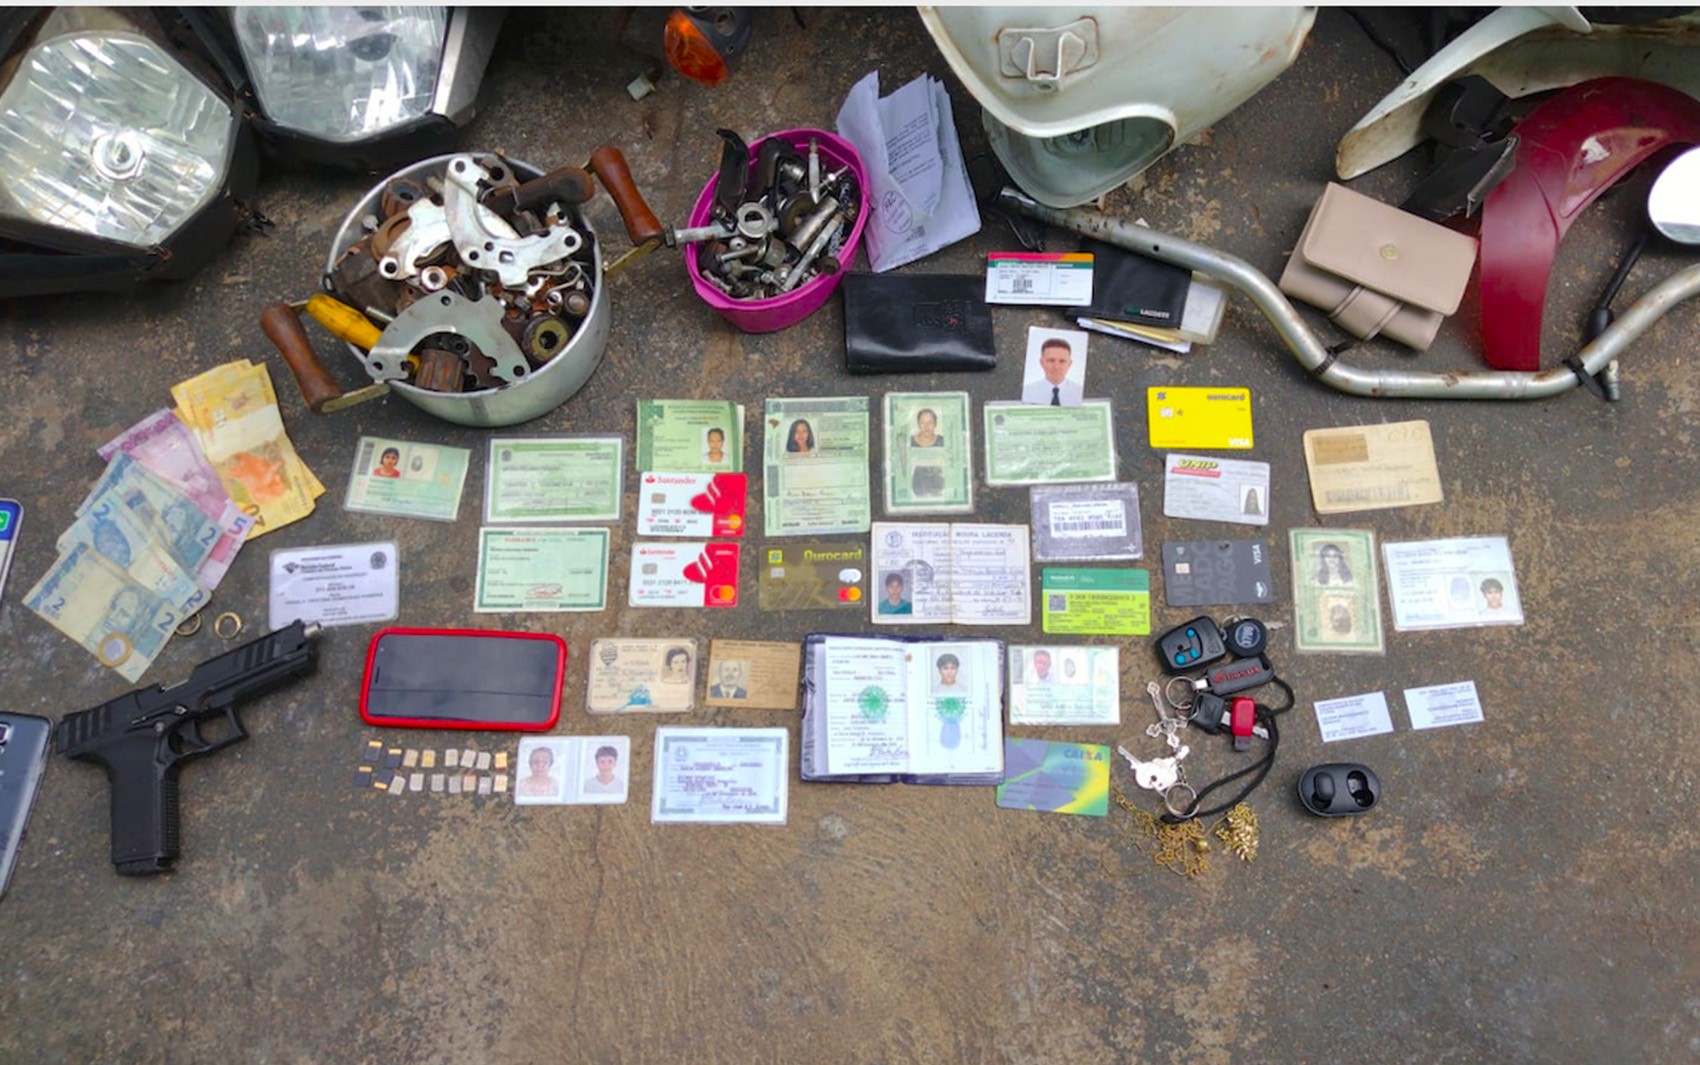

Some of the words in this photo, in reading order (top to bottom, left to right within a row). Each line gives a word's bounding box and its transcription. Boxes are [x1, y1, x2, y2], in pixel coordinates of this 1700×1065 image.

[1228, 437, 1250, 448] VISA
[1178, 459, 1218, 470] UNIP
[657, 477, 697, 485] Santander
[92, 503, 110, 521] 2
[228, 516, 247, 536] 5
[200, 526, 216, 546] 2
[804, 548, 862, 561] Ourocard
[1252, 543, 1263, 565] VISA
[52, 597, 65, 611] 2
[186, 589, 203, 608] 2
[157, 611, 175, 632] 2
[1064, 748, 1102, 762] CAIXA
